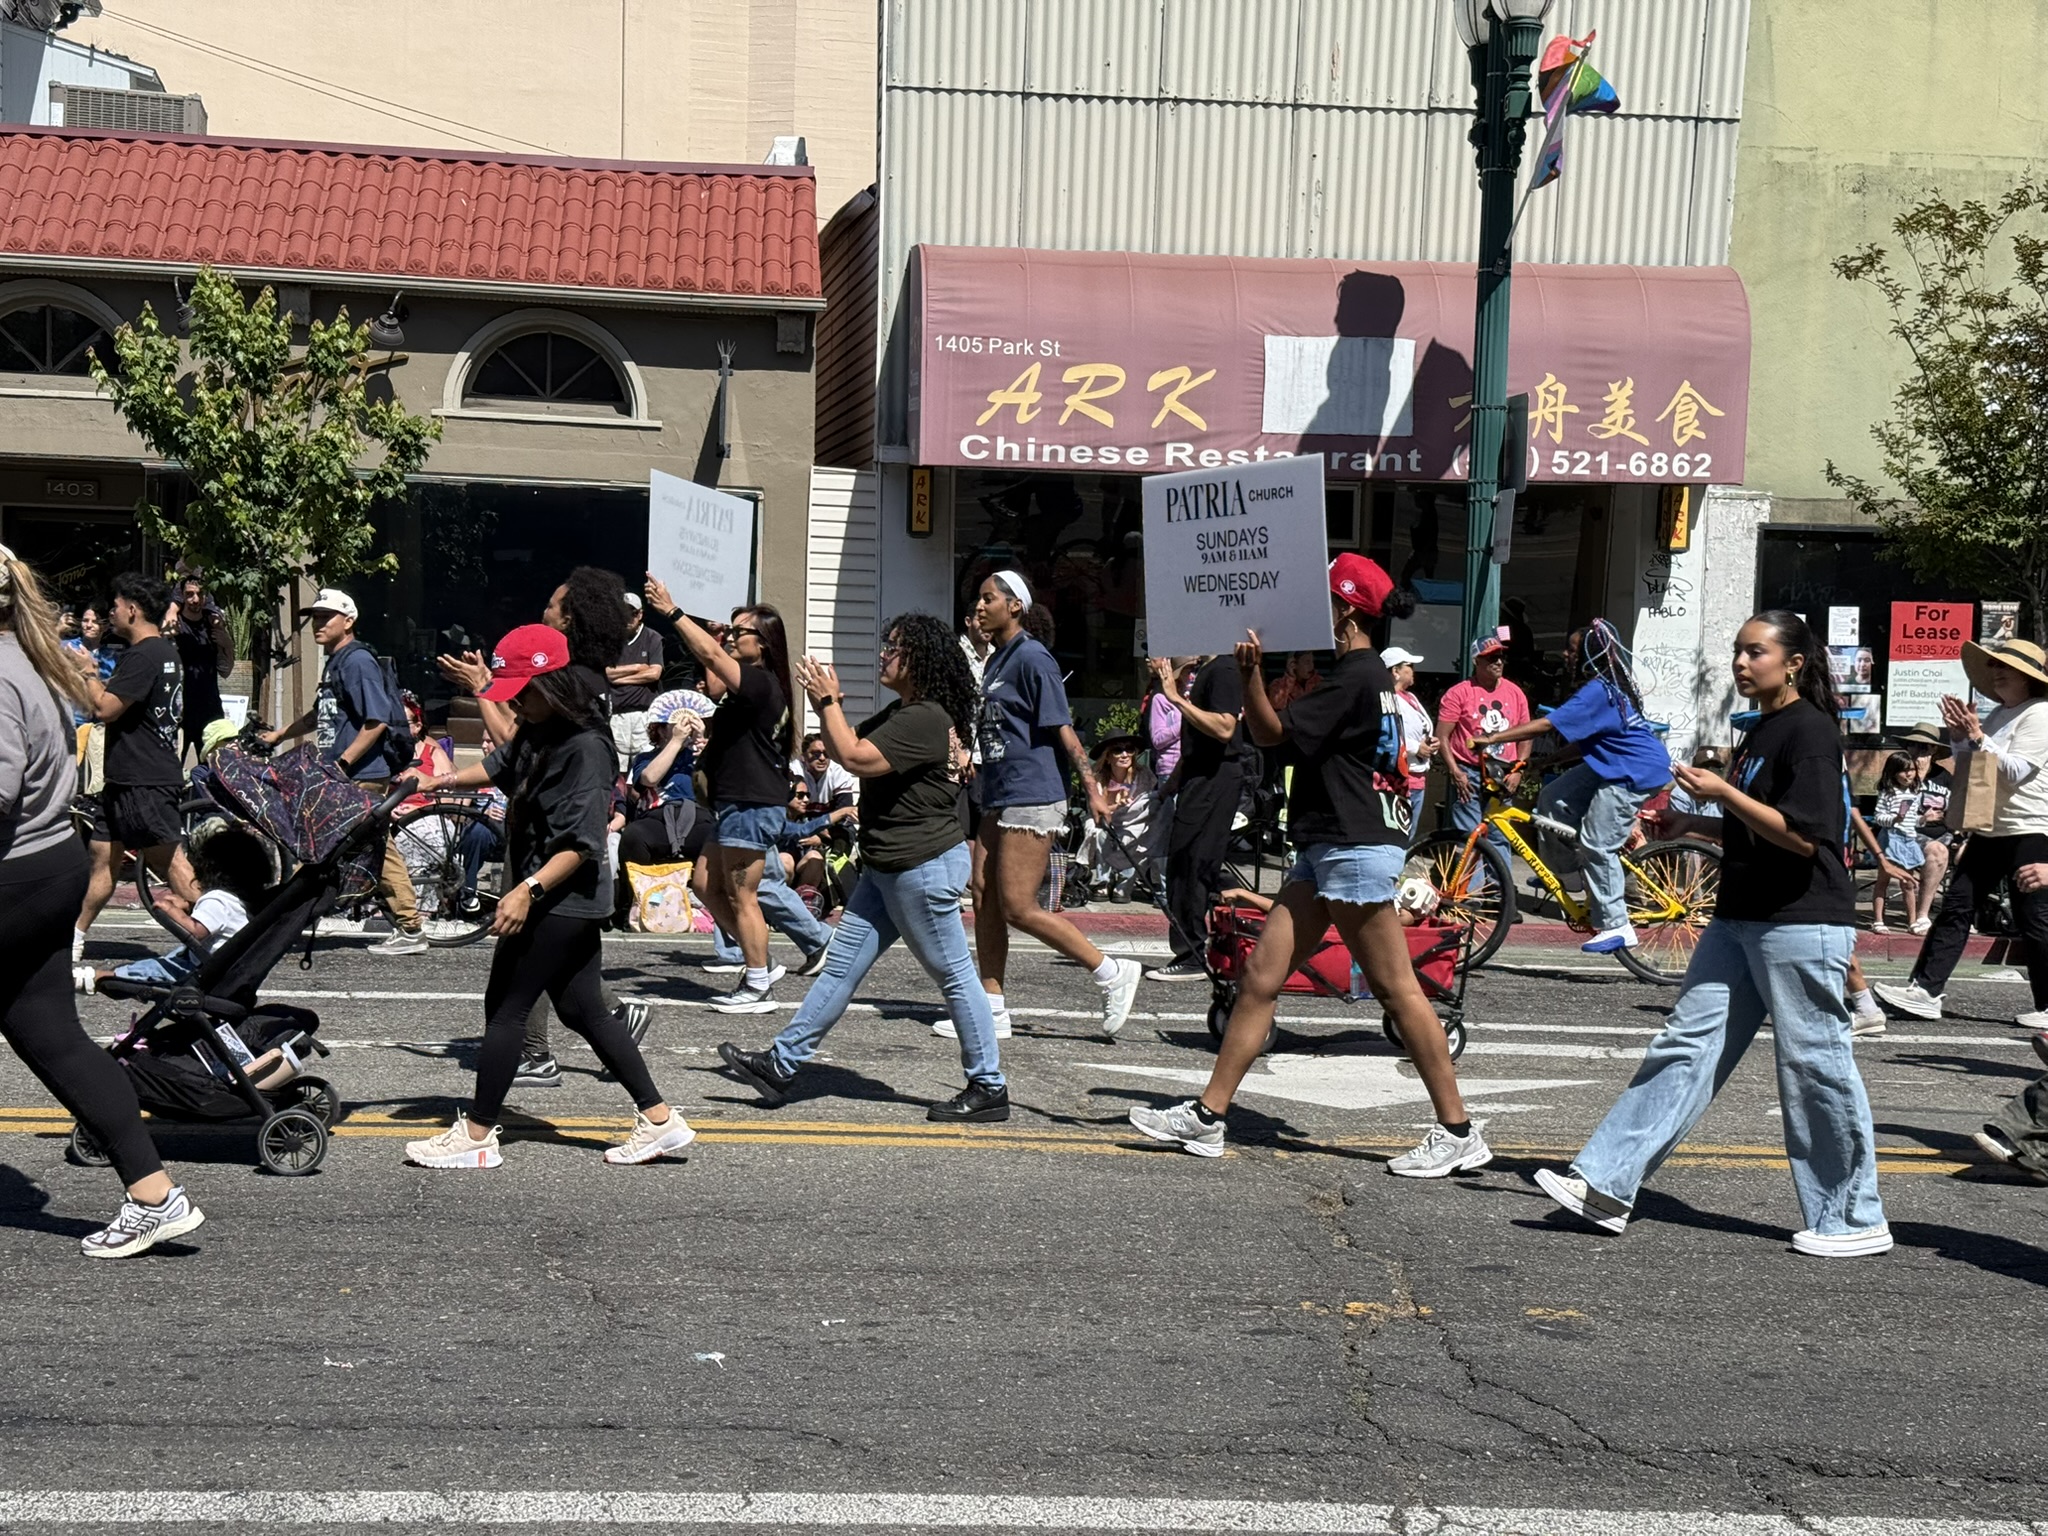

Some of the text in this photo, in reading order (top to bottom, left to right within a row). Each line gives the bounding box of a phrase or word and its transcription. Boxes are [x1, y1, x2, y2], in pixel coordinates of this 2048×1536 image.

[935, 334, 1060, 356] 1405 Park St
[976, 361, 1217, 432] ARK
[960, 434, 1150, 464] Chinese
[1165, 442, 1422, 473] Restrant
[1551, 450, 1712, 478] 521-6862
[46, 482, 95, 496] 1403
[915, 475, 928, 525] ARK
[1166, 479, 1294, 523] PATRIA CHURCH
[1672, 493, 1685, 540] ARK
[1196, 526, 1269, 550] SUNDAYS
[1201, 547, 1269, 565] 9AM & 11AM
[1184, 571, 1280, 593] WEDNESDAY
[1218, 594, 1245, 607] 7PM
[1648, 606, 1686, 618] PABLO
[1915, 605, 1950, 621] For
[1902, 623, 1961, 640] Lease
[1895, 644, 1961, 656] 415.395.726
[1893, 669, 1943, 677] Justin Choi
[1891, 690, 1908, 698] Jeff
